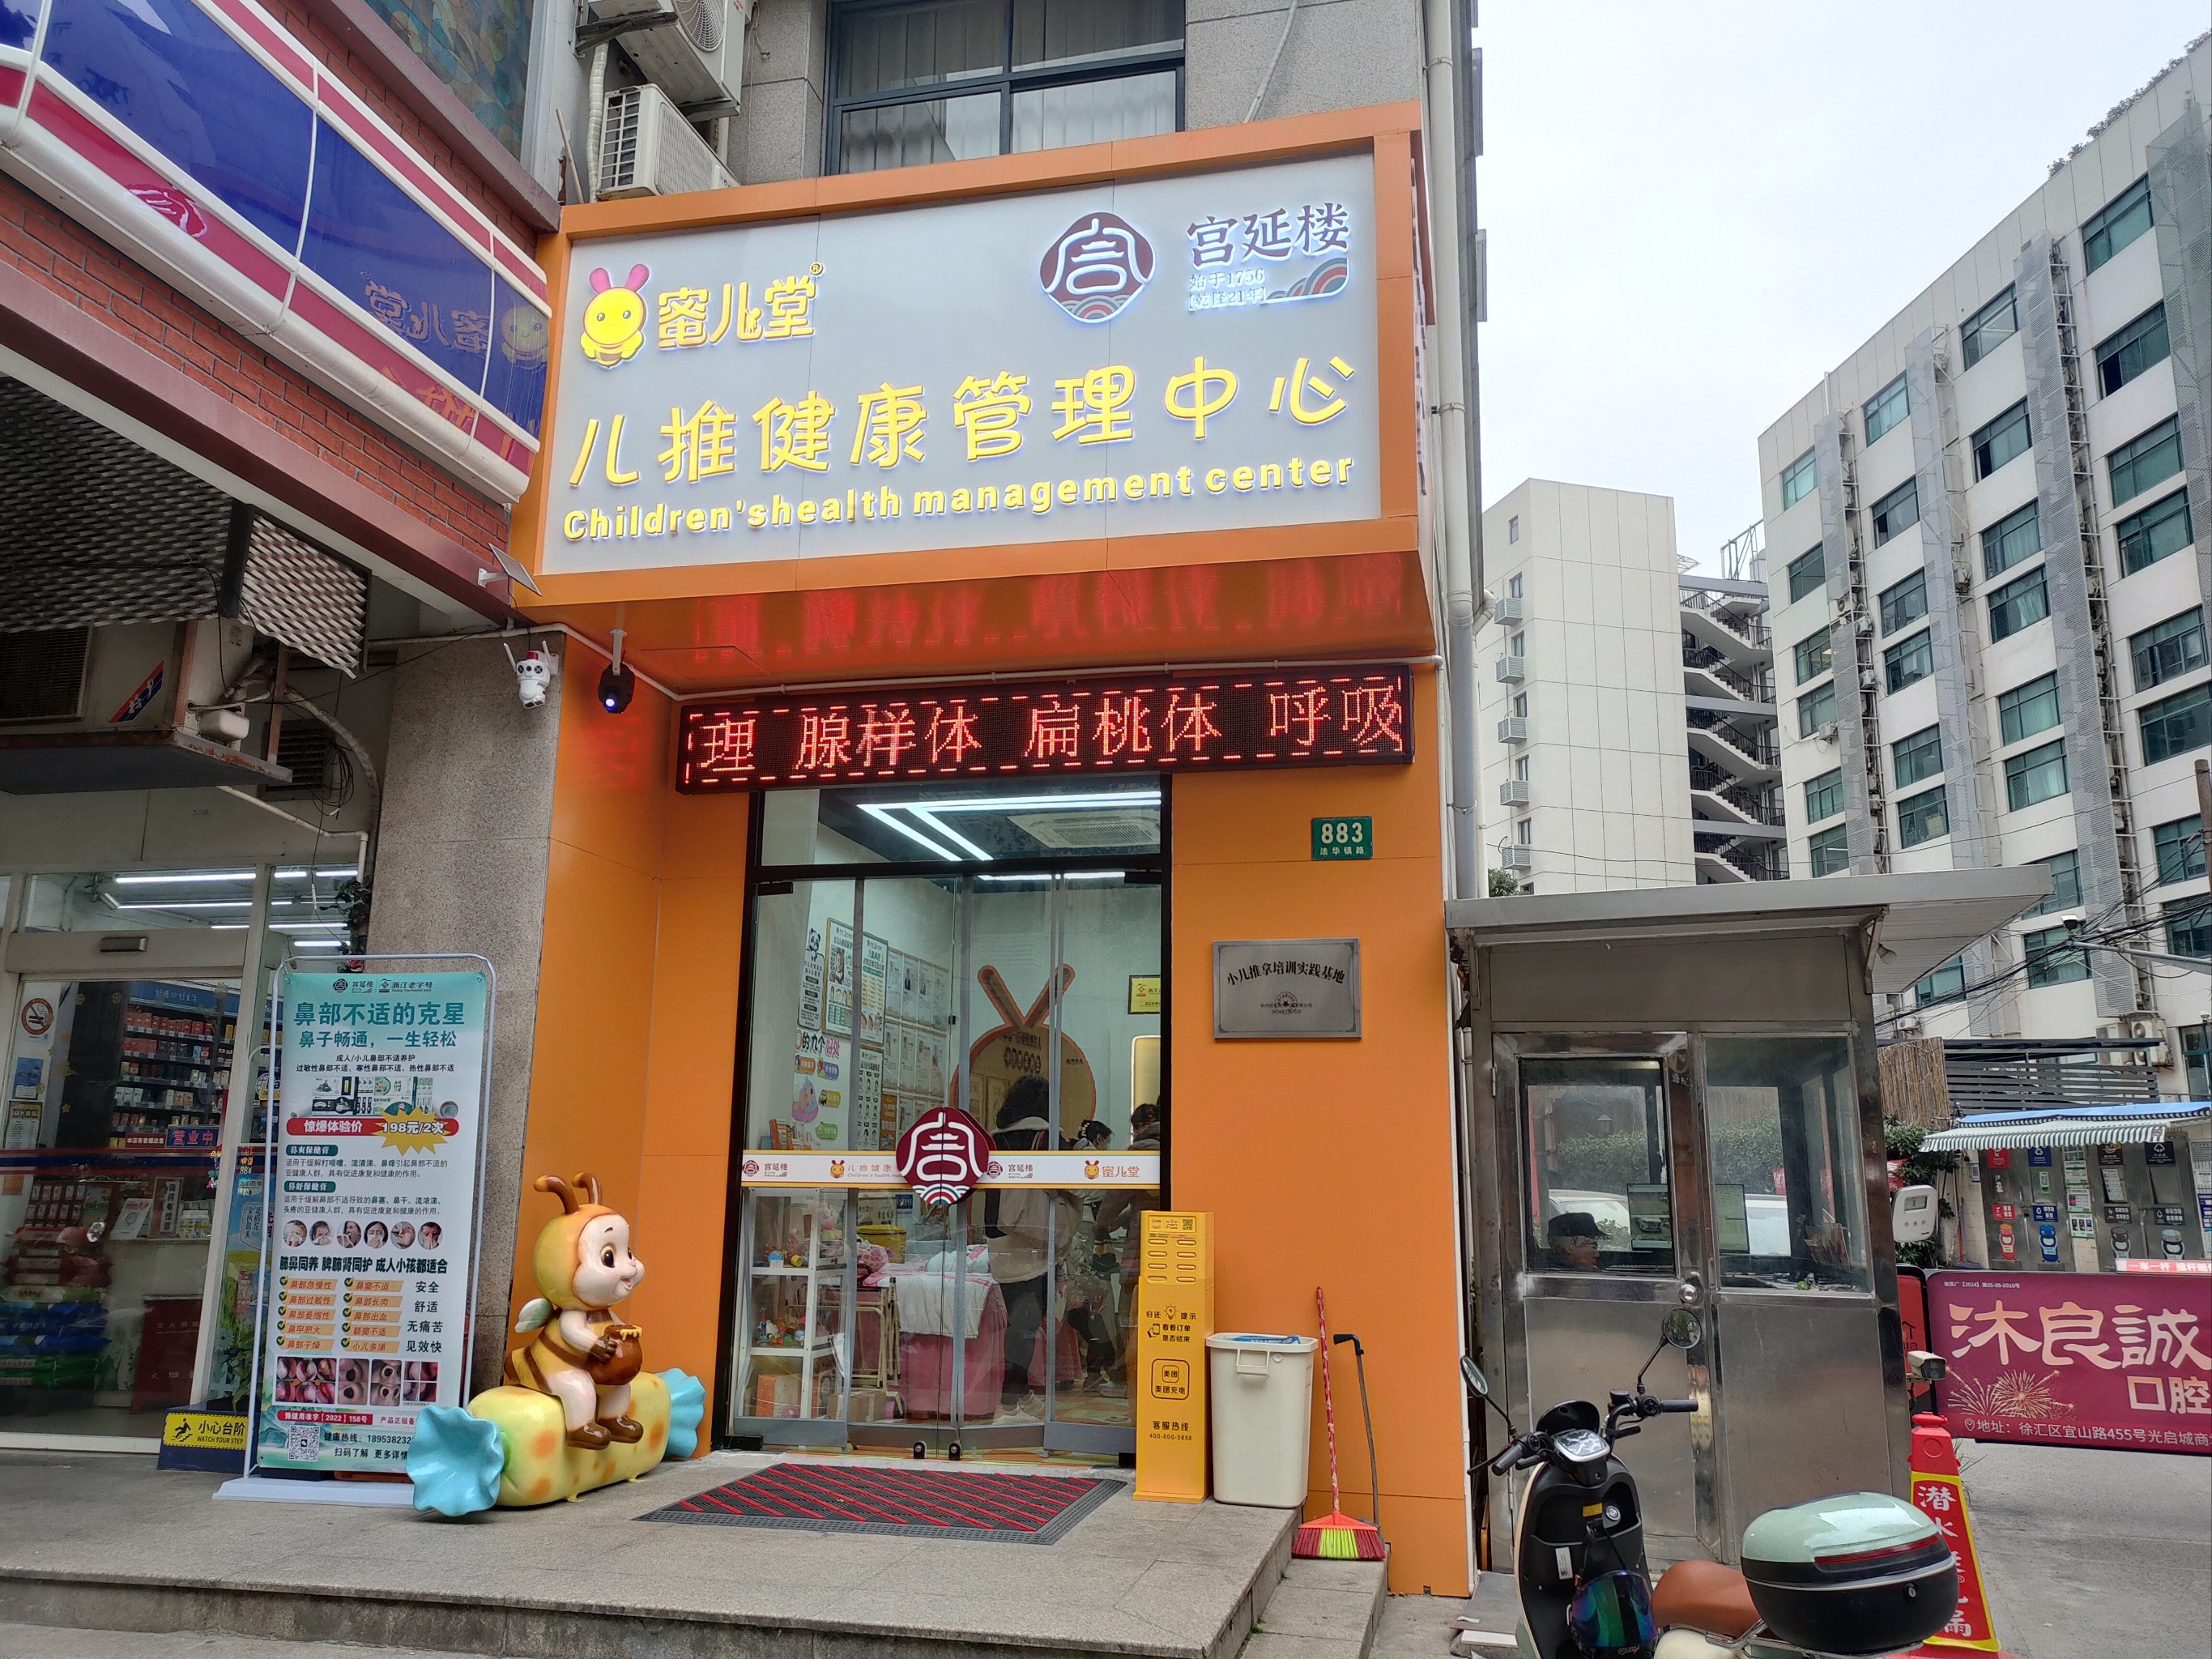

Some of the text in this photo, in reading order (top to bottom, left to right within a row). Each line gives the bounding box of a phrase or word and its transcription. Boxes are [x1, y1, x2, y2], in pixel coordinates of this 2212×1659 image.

[1187, 203, 1349, 270] 宫延楼
[1189, 268, 1265, 291] 始于1756
[658, 273, 816, 351] 蜜儿堂
[569, 356, 1355, 488] 儿推健康管理中心
[912, 467, 1192, 519] management
[1205, 454, 1353, 493] center
[795, 706, 981, 770] 腺样体
[1024, 693, 1221, 760] 扁桃体
[1268, 684, 1402, 747] 呼吸
[1321, 822, 1363, 844] 883
[1320, 847, 1365, 855] 法华镇路
[1227, 961, 1345, 986] 小儿推拿培训实践基地
[391, 981, 433, 989] 浙江老字号
[294, 1001, 465, 1026] 鼻部不适的克星
[299, 1030, 457, 1048] 鼻子畅通，一生轻松
[336, 1054, 416, 1063] 成人/小儿鼻部不适养护
[296, 1064, 454, 1073] 过敏性鼻部不适、寒性鼻部不适、热性鼻部不适
[304, 1120, 444, 1135] 惊爆体验价 198元/2次
[173, 1129, 213, 1145] 营业中
[764, 1162, 788, 1171] 宫延楼
[1008, 1164, 1034, 1172] 宫延楼
[1102, 1166, 1140, 1178] 蜜儿堂
[279, 1256, 319, 1270] 肺鼻同养
[376, 1257, 448, 1274] 成人小孩都适合
[289, 1279, 332, 1290] 鼻部急慢性
[415, 1281, 440, 1294] 安全
[289, 1295, 331, 1306] 鼻部过敏性
[414, 1300, 438, 1313] 舒适
[353, 1311, 388, 1322] 鼻部出血
[407, 1320, 443, 1334] 无痛苦
[1180, 1311, 1197, 1320] 提示
[287, 1324, 322, 1335] 鼻甲肥大
[1949, 1300, 2212, 1371] 沐良誠
[287, 1339, 321, 1350] 鼻部干燥
[406, 1341, 442, 1353] 见效快
[1155, 1385, 1186, 1395] 美团充电
[2127, 1376, 2212, 1414] 口腔
[198, 1420, 245, 1436] 小心台阶
[380, 1416, 417, 1425] 产品正规备
[1153, 1420, 1189, 1431] 客服热线
[197, 1435, 244, 1444] WATCH YOUR STEP
[324, 1431, 414, 1445] 健康热线：189538232
[1976, 1418, 2212, 1448] 地址：徐汇区宜山路455号光启城商
[335, 1448, 369, 1458] 扫码了解
